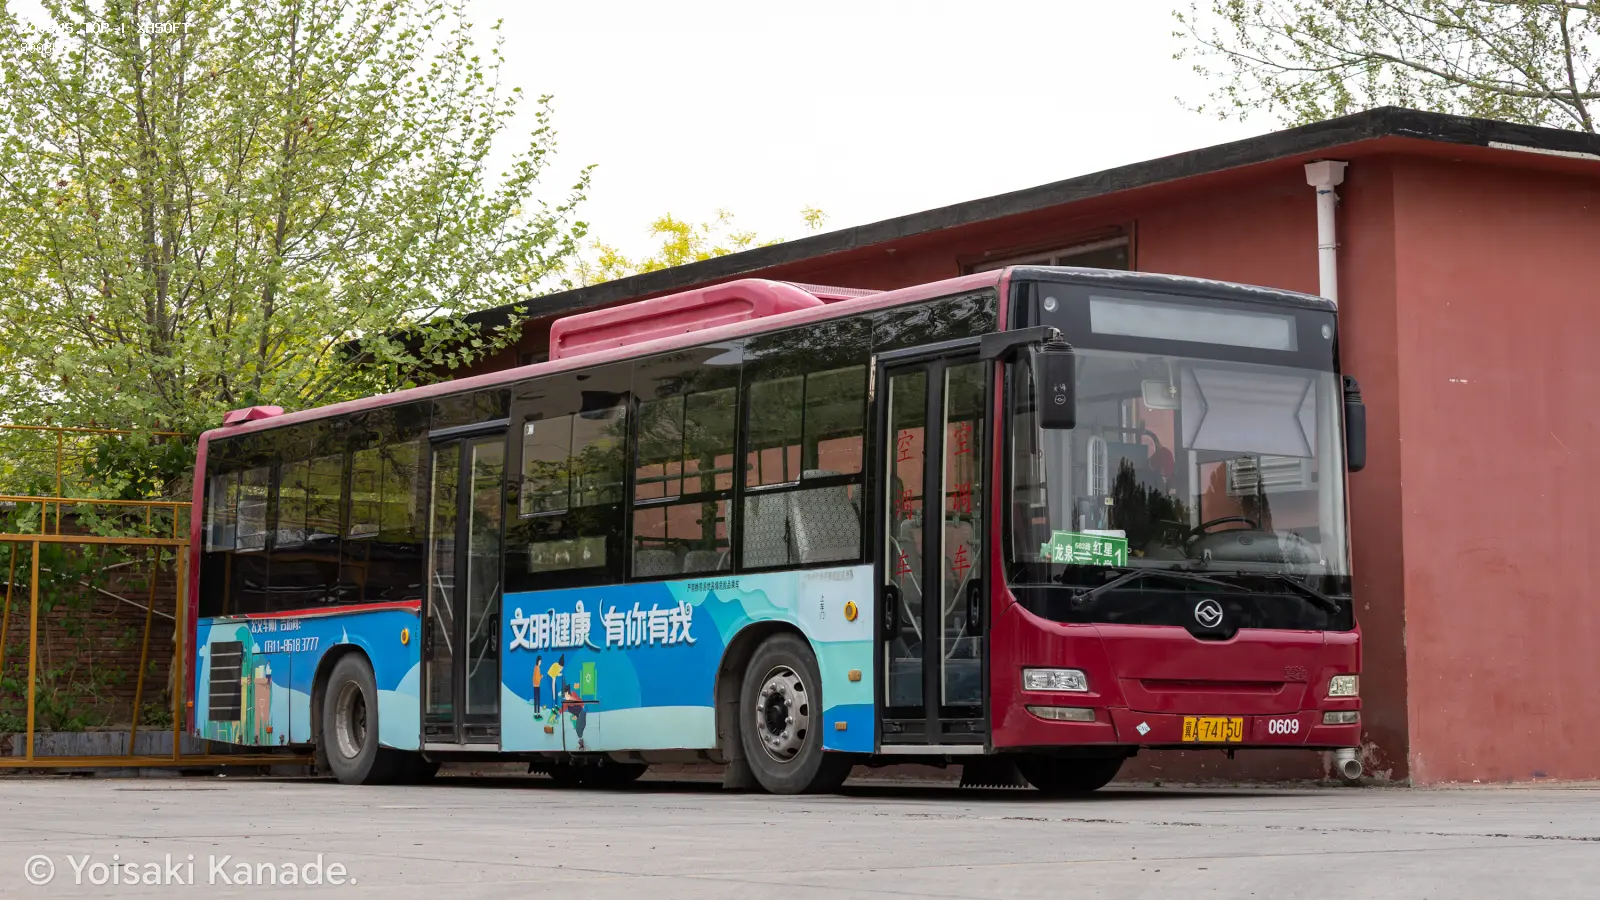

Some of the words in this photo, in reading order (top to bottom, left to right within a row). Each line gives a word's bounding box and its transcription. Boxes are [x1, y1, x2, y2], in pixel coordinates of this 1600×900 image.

[895, 430, 914, 584] 空调车
[952, 421, 972, 581] 空调车
[1055, 544, 1074, 562] 龙泉
[1093, 541, 1113, 557] 红星
[509, 600, 599, 650] 文明健康
[600, 599, 697, 647] 有你有我
[1268, 719, 1299, 734] 0609
